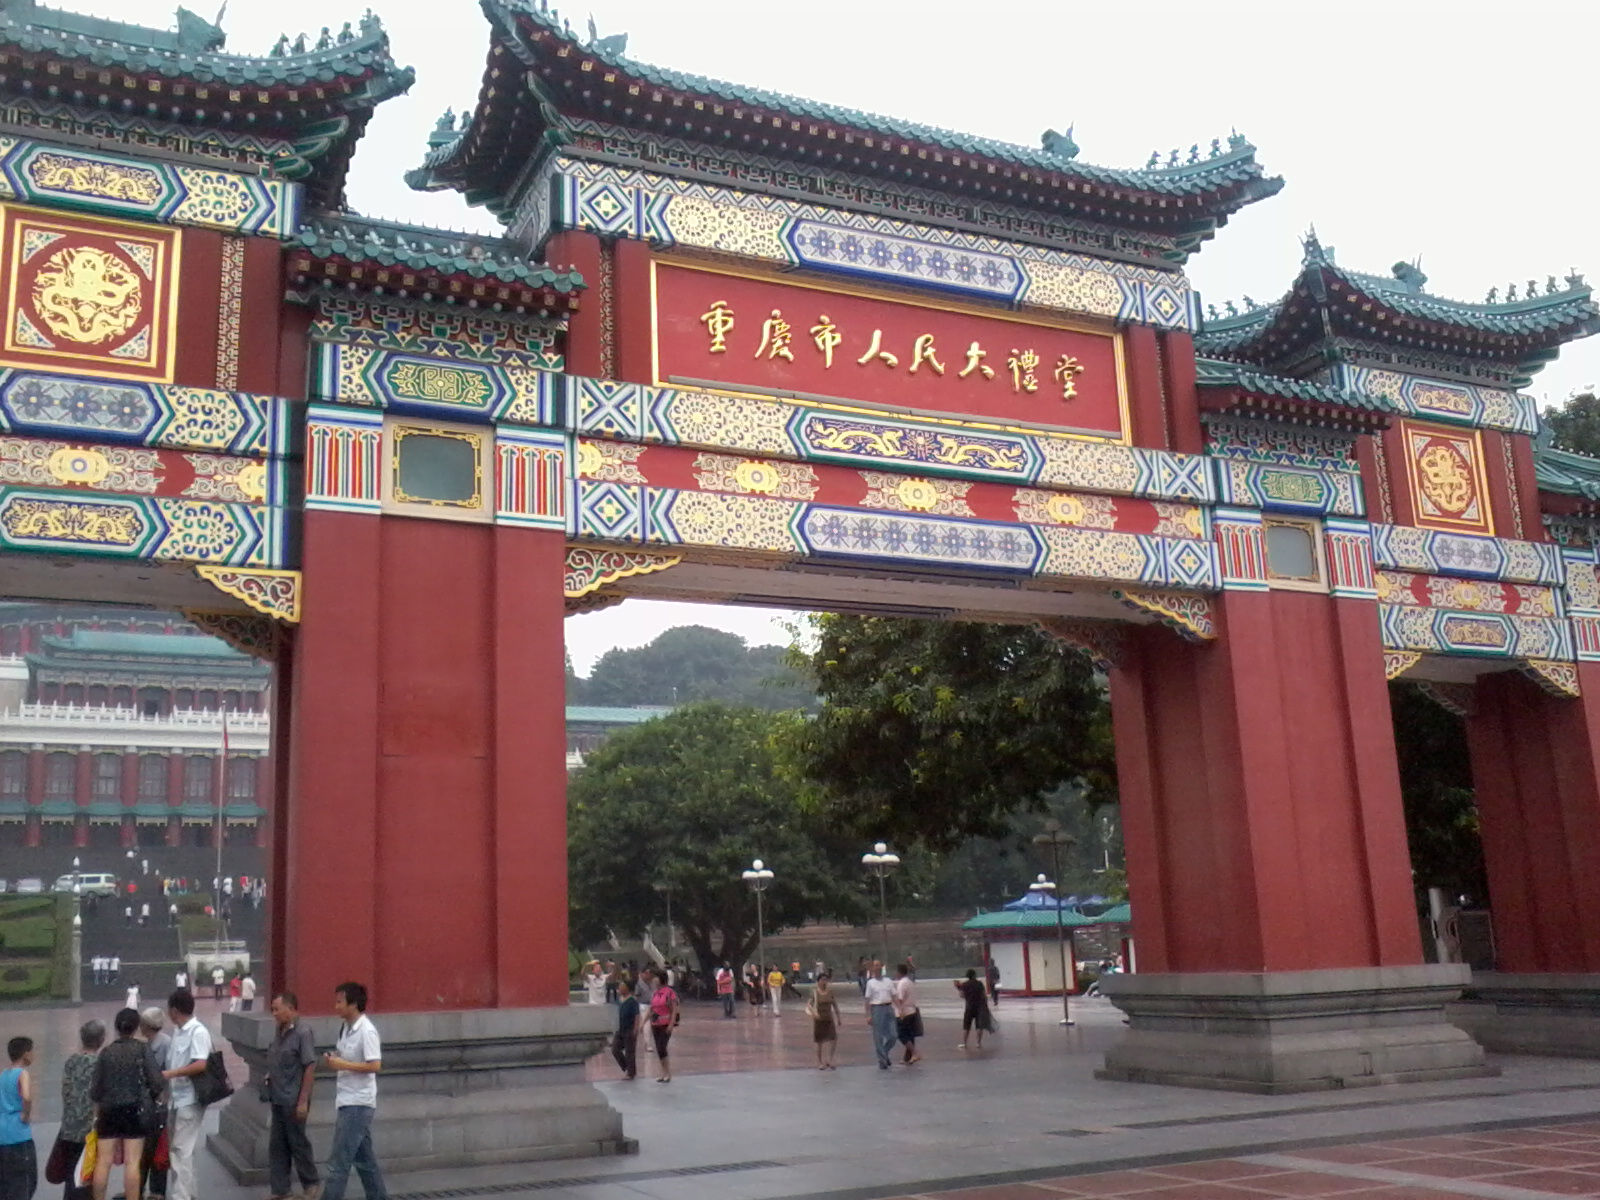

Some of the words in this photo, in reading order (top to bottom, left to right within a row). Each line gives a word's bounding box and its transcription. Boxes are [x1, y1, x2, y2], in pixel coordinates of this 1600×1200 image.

[701, 300, 1085, 399] 重慶市人民大禮堂
